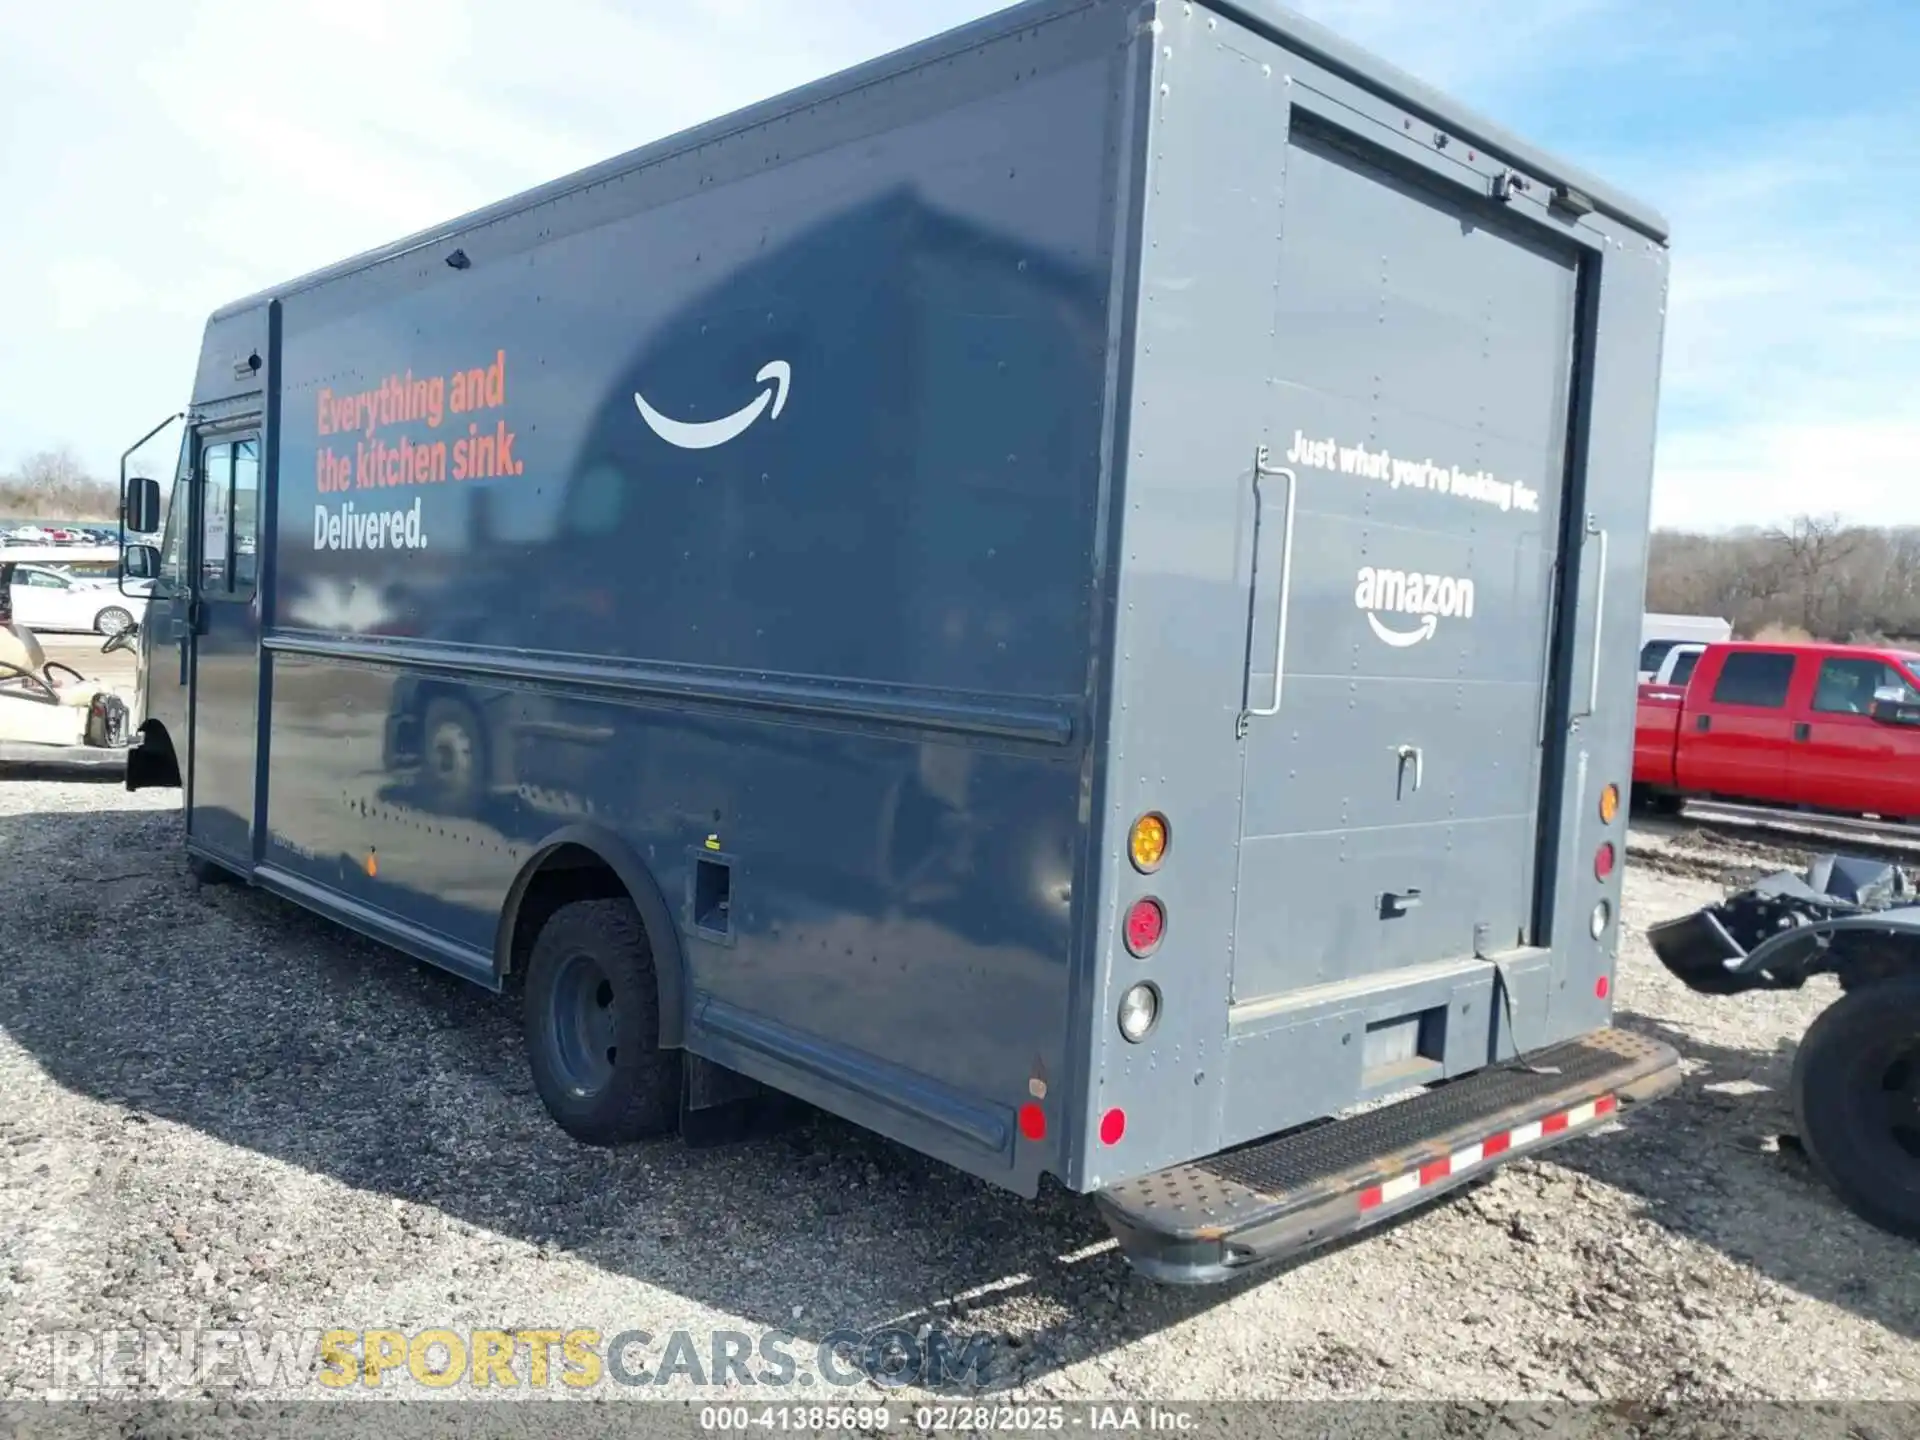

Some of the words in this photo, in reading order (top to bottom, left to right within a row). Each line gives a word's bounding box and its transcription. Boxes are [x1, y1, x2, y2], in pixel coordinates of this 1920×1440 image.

[315, 367, 444, 438] Everything
[450, 349, 505, 413] and
[316, 447, 350, 493] the
[355, 435, 447, 488] kitchen
[452, 419, 524, 481] sink.
[1286, 429, 1337, 472] Just
[1339, 442, 1390, 482] what
[1390, 458, 1449, 494] you're
[1450, 464, 1512, 513] looking
[1512, 479, 1540, 513] for.
[313, 496, 427, 550] Delivered.
[1355, 566, 1475, 619] amazon
